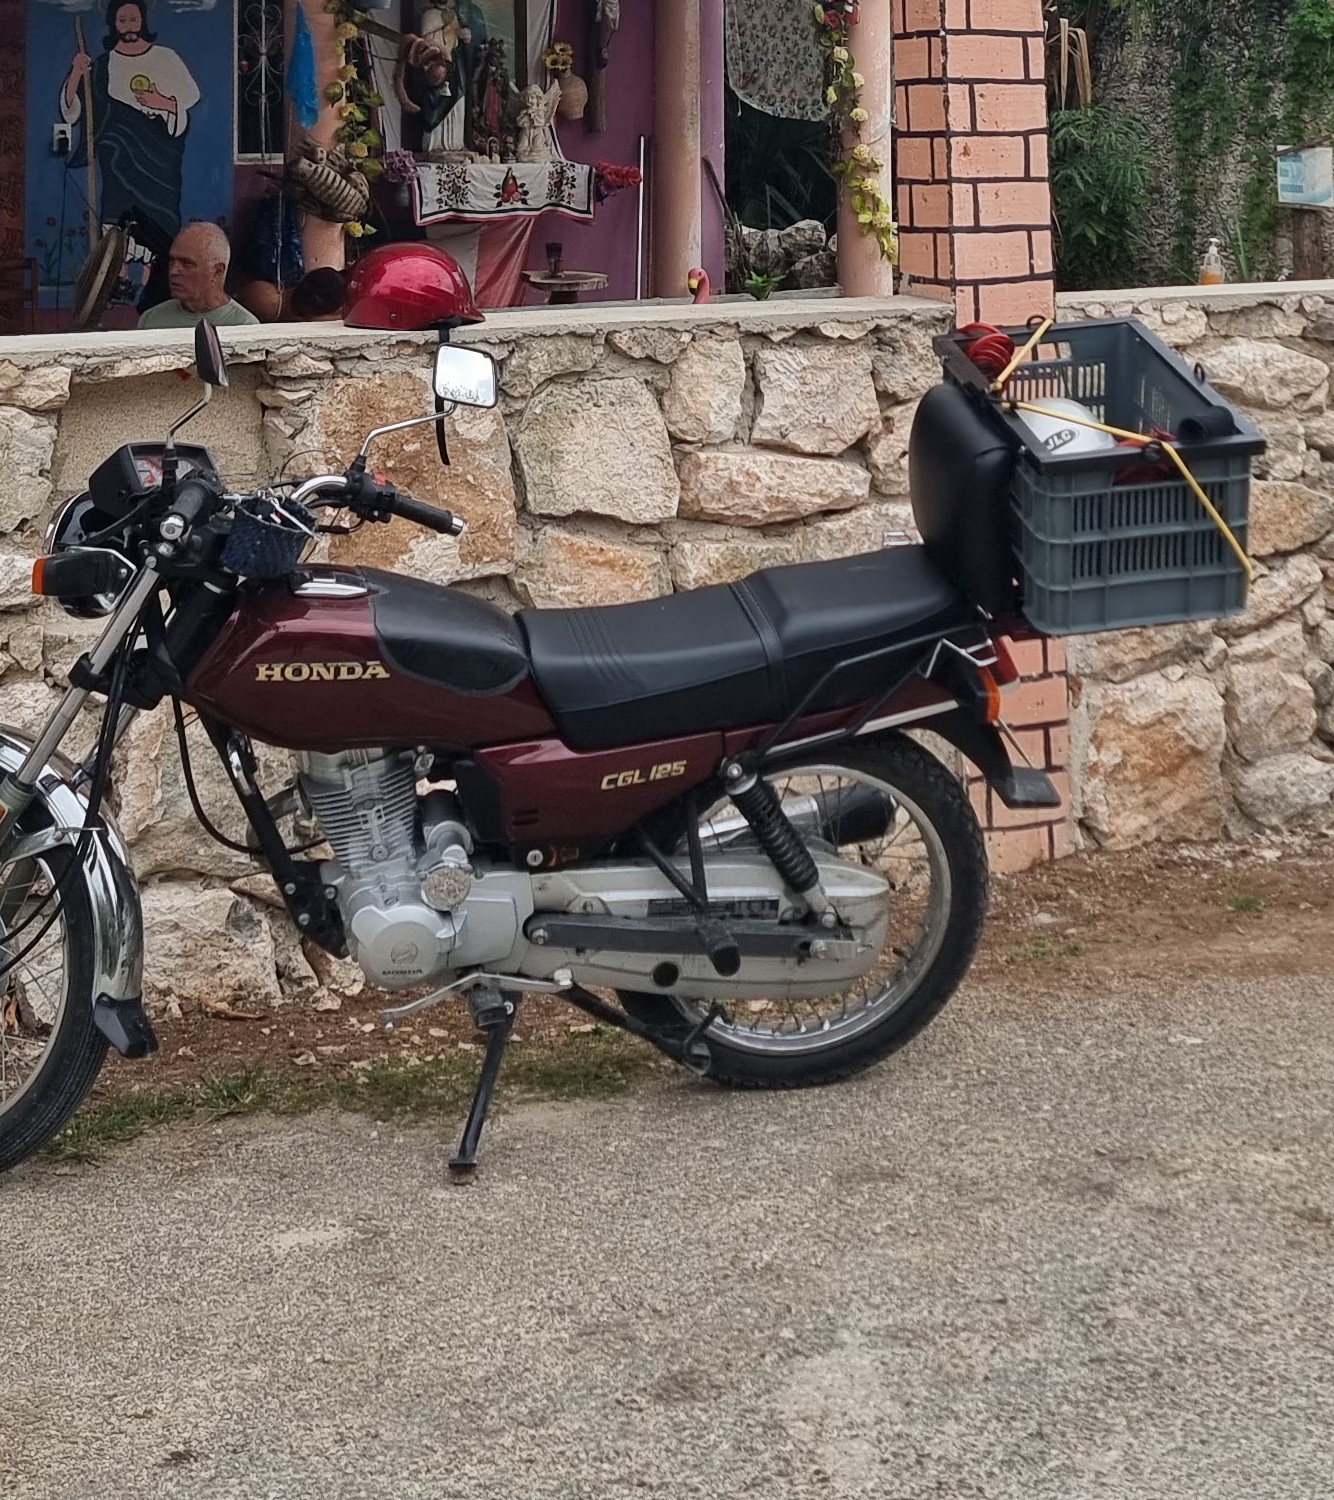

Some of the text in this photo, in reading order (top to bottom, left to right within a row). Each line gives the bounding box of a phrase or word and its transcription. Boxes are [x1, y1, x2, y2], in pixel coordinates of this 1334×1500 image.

[255, 661, 391, 681] HONDA
[601, 760, 687, 790] CGL 125
